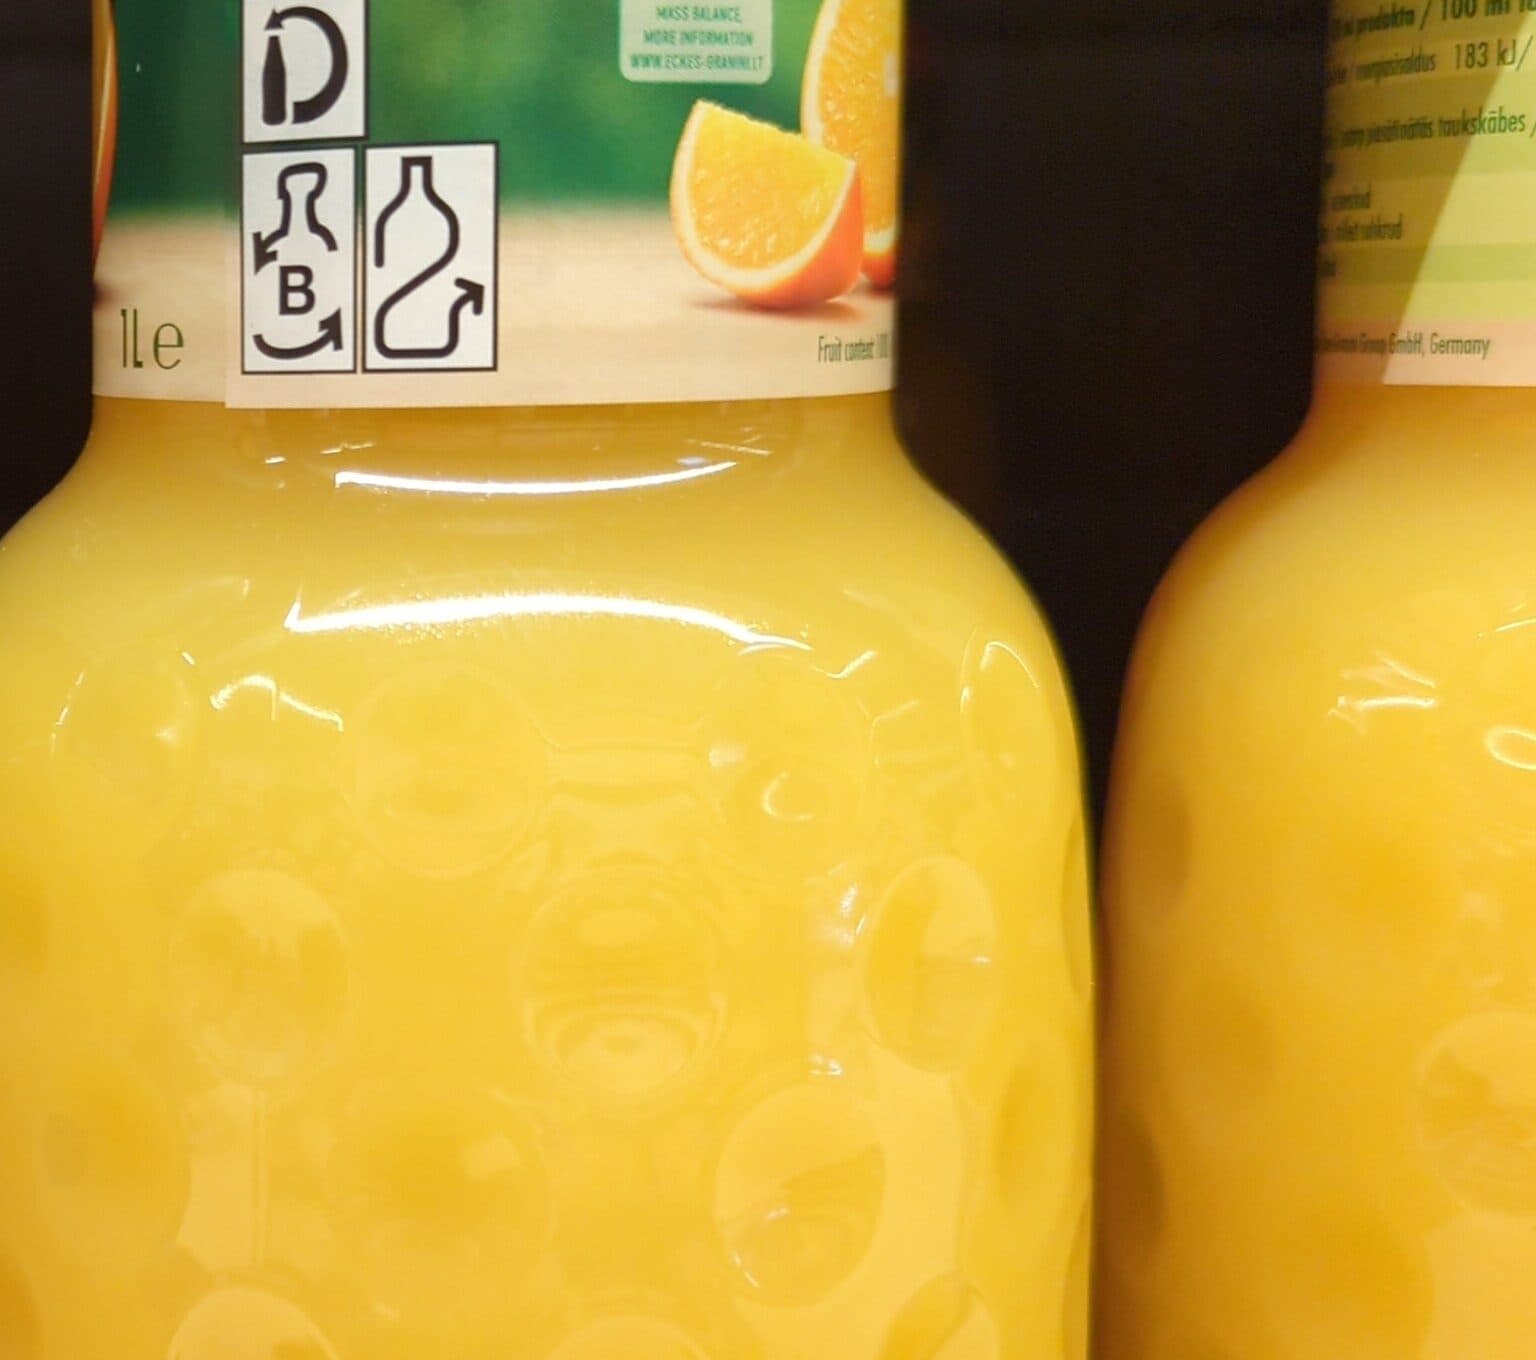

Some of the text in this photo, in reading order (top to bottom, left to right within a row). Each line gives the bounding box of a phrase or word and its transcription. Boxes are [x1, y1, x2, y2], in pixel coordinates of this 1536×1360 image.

[643, 30, 754, 46] MORE INFORMATION
[1455, 42, 1489, 71] 183
[278, 265, 316, 316] B
[1429, 332, 1491, 360] Germany
